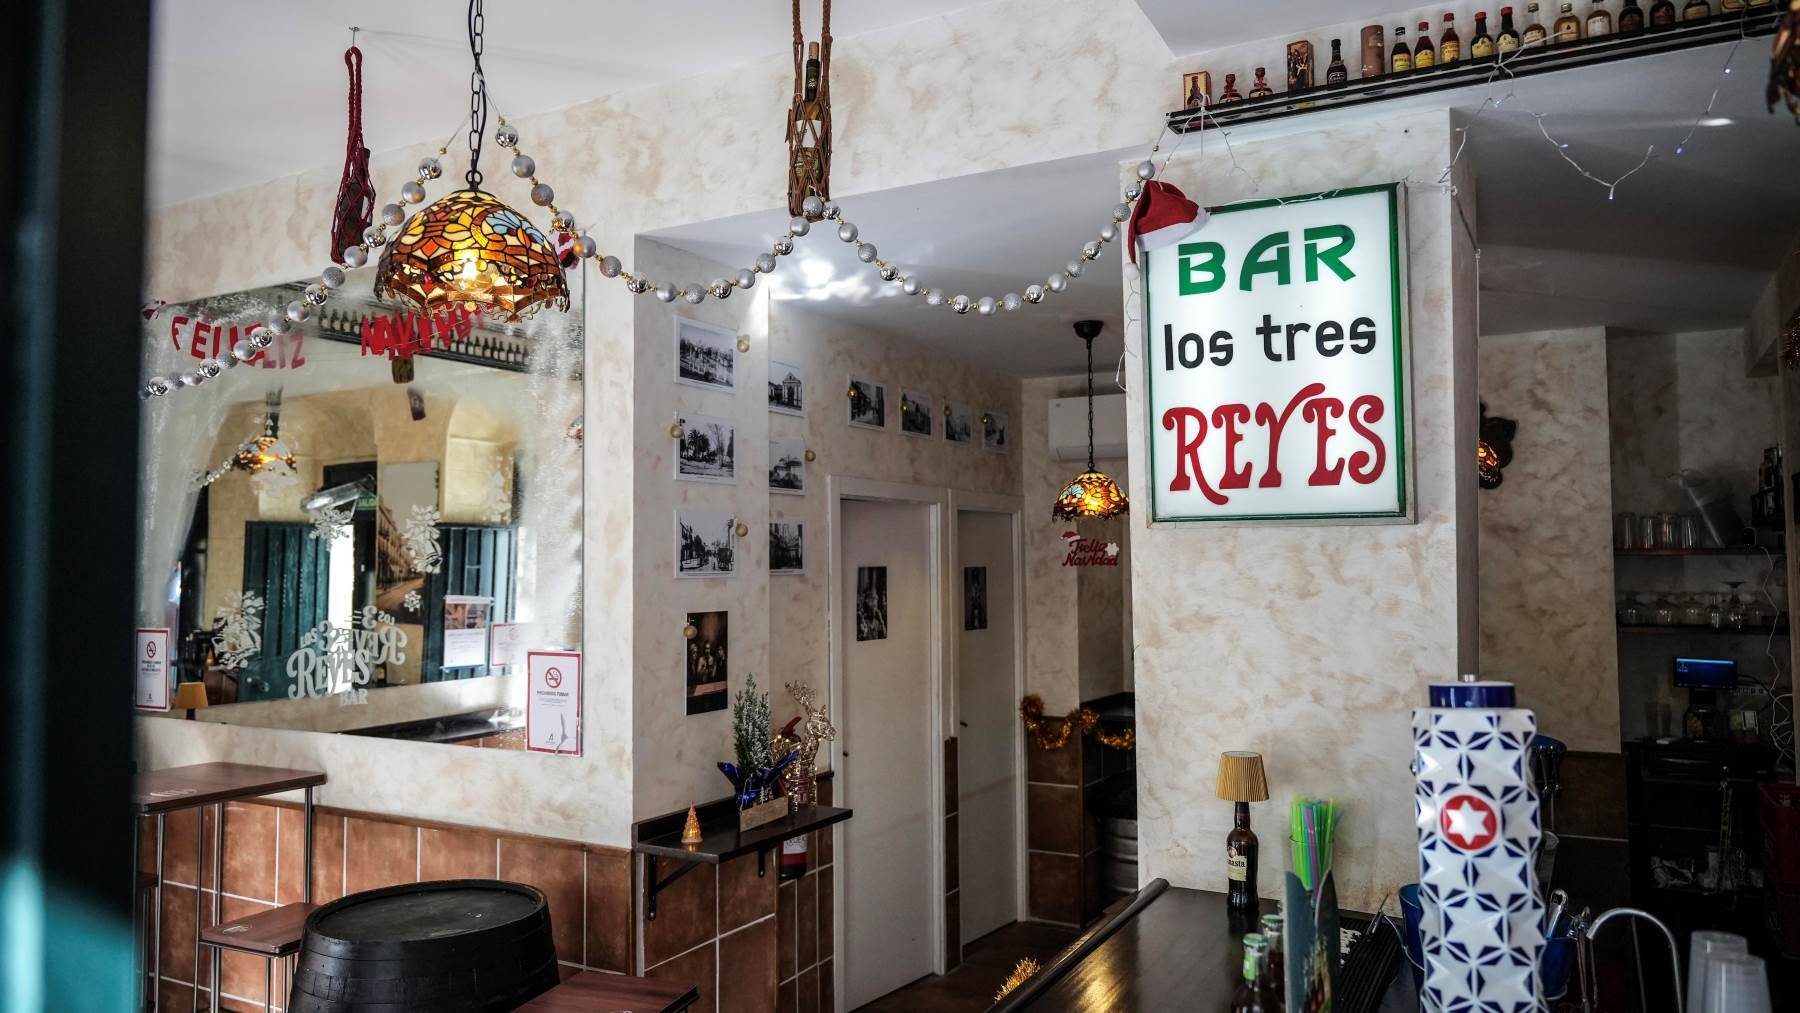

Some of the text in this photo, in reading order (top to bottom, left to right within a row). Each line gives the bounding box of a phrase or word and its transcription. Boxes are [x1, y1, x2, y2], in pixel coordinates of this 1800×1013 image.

[1177, 224, 1356, 296] BAR
[1164, 314, 1376, 371] los tres
[1162, 383, 1386, 505] REYES
[1062, 552, 1119, 566] Navidad
[1069, 538, 1108, 553] Feliz
[286, 648, 370, 700] REYES
[340, 688, 369, 705] BAR
